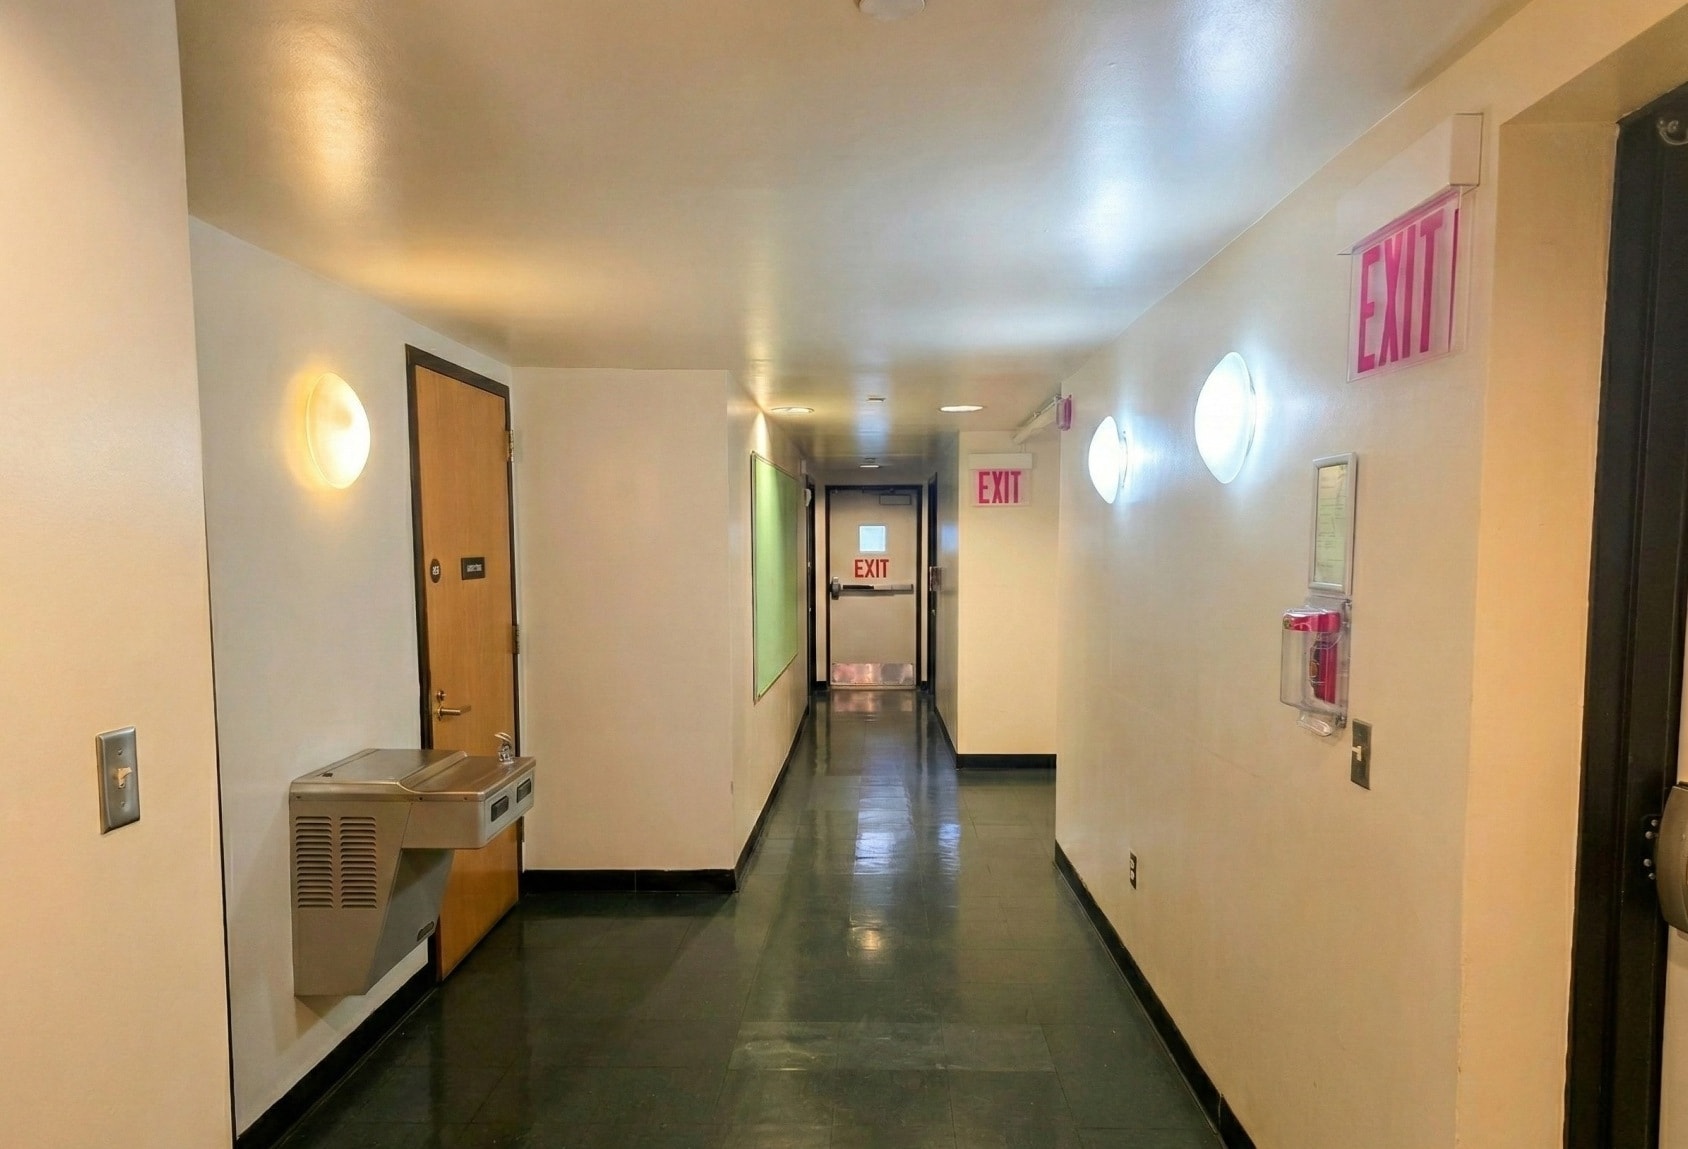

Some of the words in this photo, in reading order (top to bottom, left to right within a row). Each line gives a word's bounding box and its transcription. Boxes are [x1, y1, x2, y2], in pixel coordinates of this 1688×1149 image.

[1357, 207, 1445, 374] EXIT
[978, 471, 1022, 504] EXIT
[854, 559, 890, 578] EXIT
